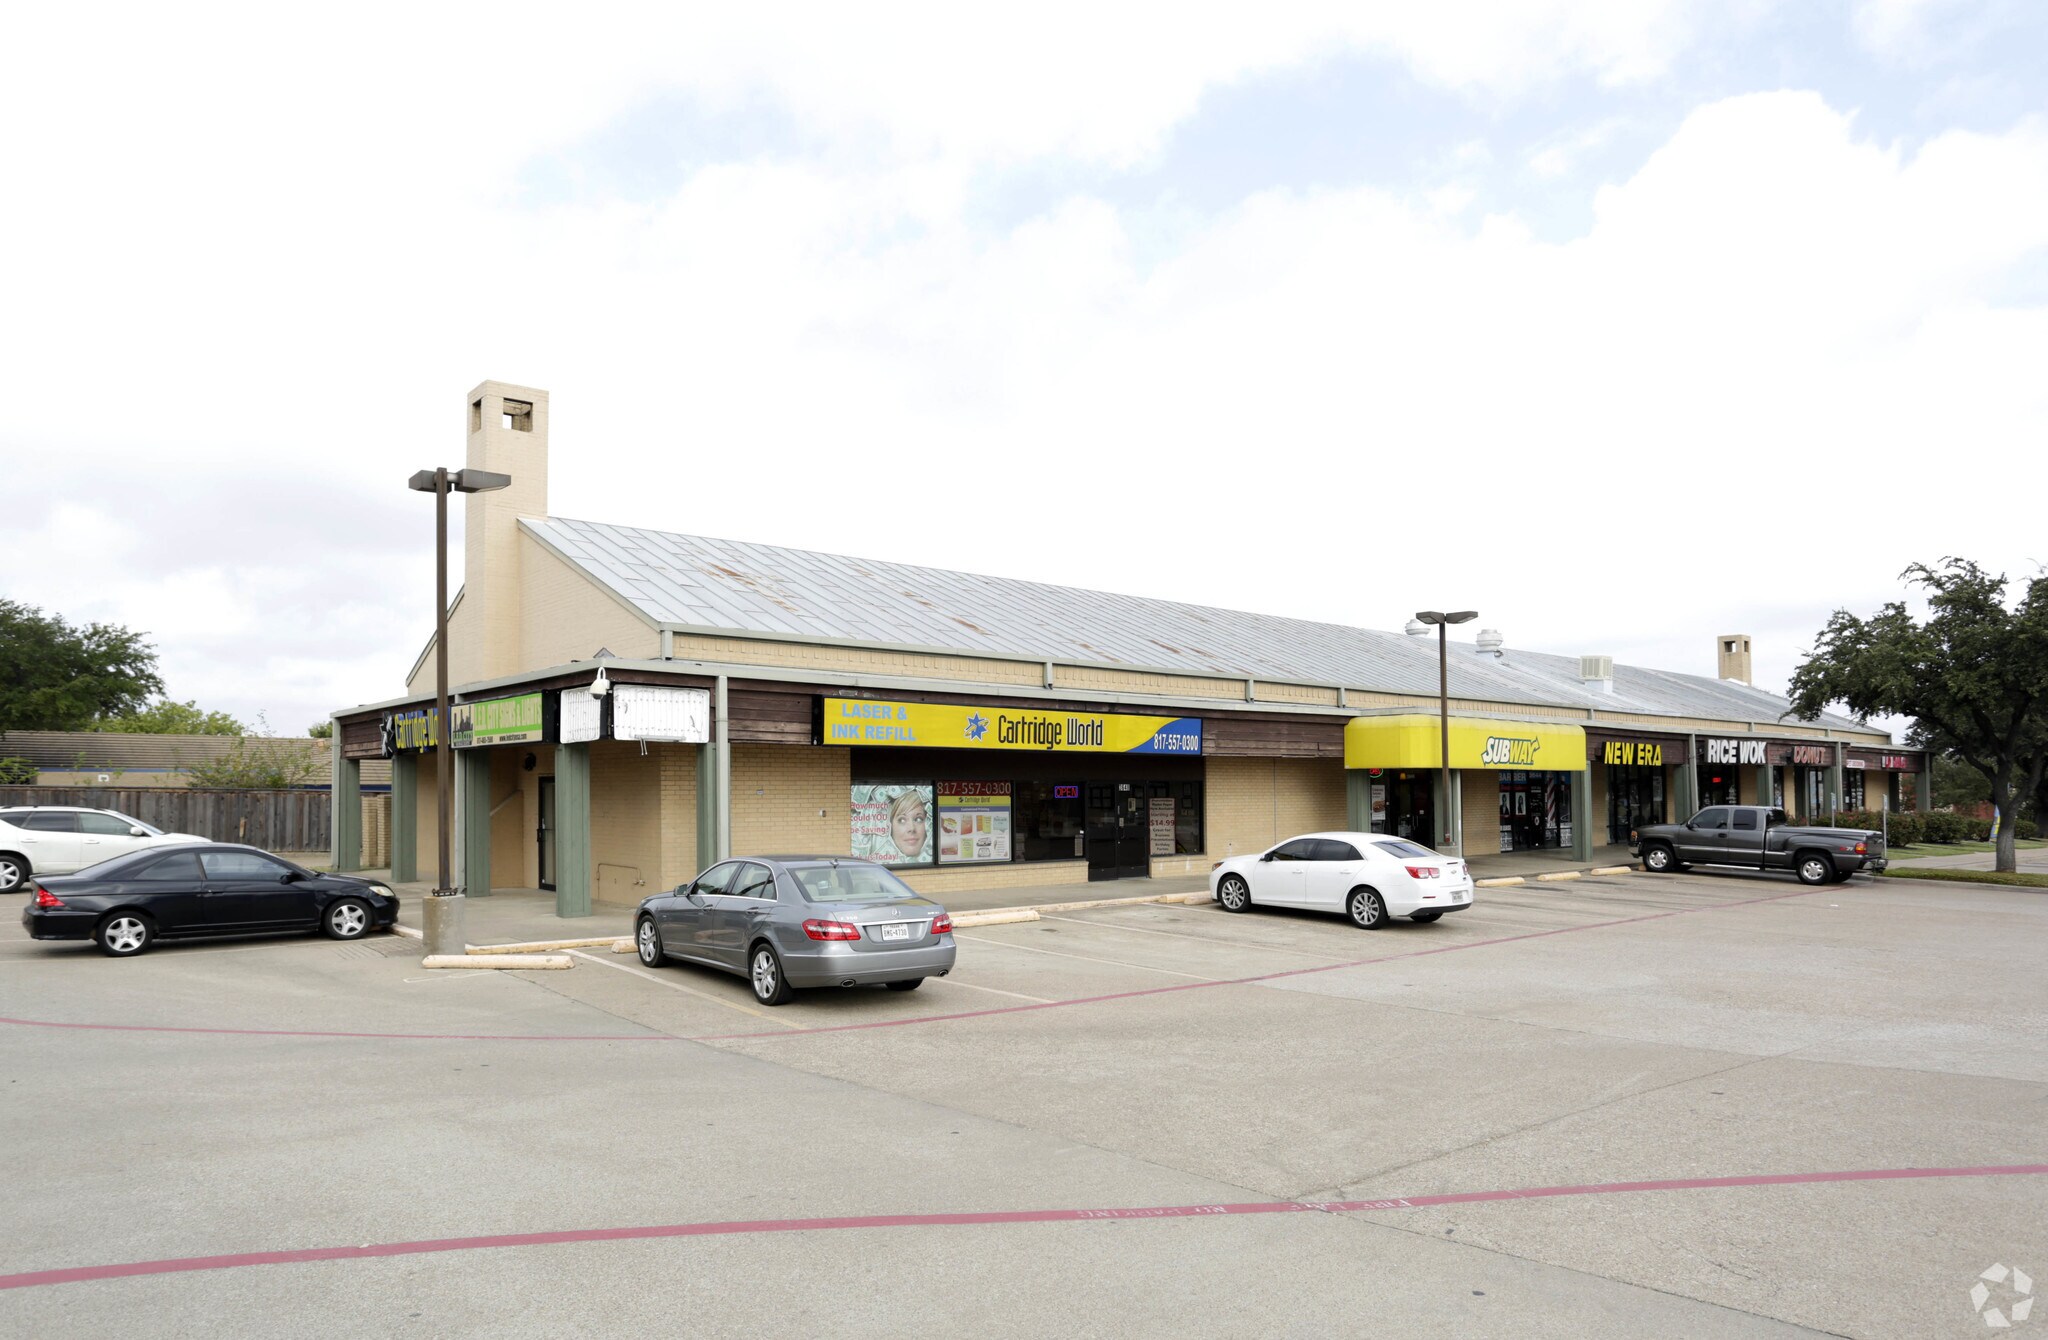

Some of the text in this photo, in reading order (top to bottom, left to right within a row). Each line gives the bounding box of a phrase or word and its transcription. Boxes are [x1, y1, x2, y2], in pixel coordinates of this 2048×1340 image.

[842, 703, 907, 720] LASER &
[394, 711, 428, 753] Cartridge
[832, 723, 917, 741] INK REFILL
[998, 715, 1103, 749] Cartridge World
[1153, 733, 1199, 751] 817-557-0300
[1481, 736, 1540, 767] SUBWAY
[1604, 741, 1662, 766] NEW ERA
[1707, 739, 1767, 764] RICE WOK
[1793, 746, 1826, 764] DONUT
[937, 782, 1012, 794] 817-557-0300
[1056, 787, 1078, 797] OPEN
[871, 813, 887, 821] YOU
[861, 825, 889, 835] Saving?
[875, 852, 899, 861] Today!
[1195, 1204, 1228, 1215] NO
